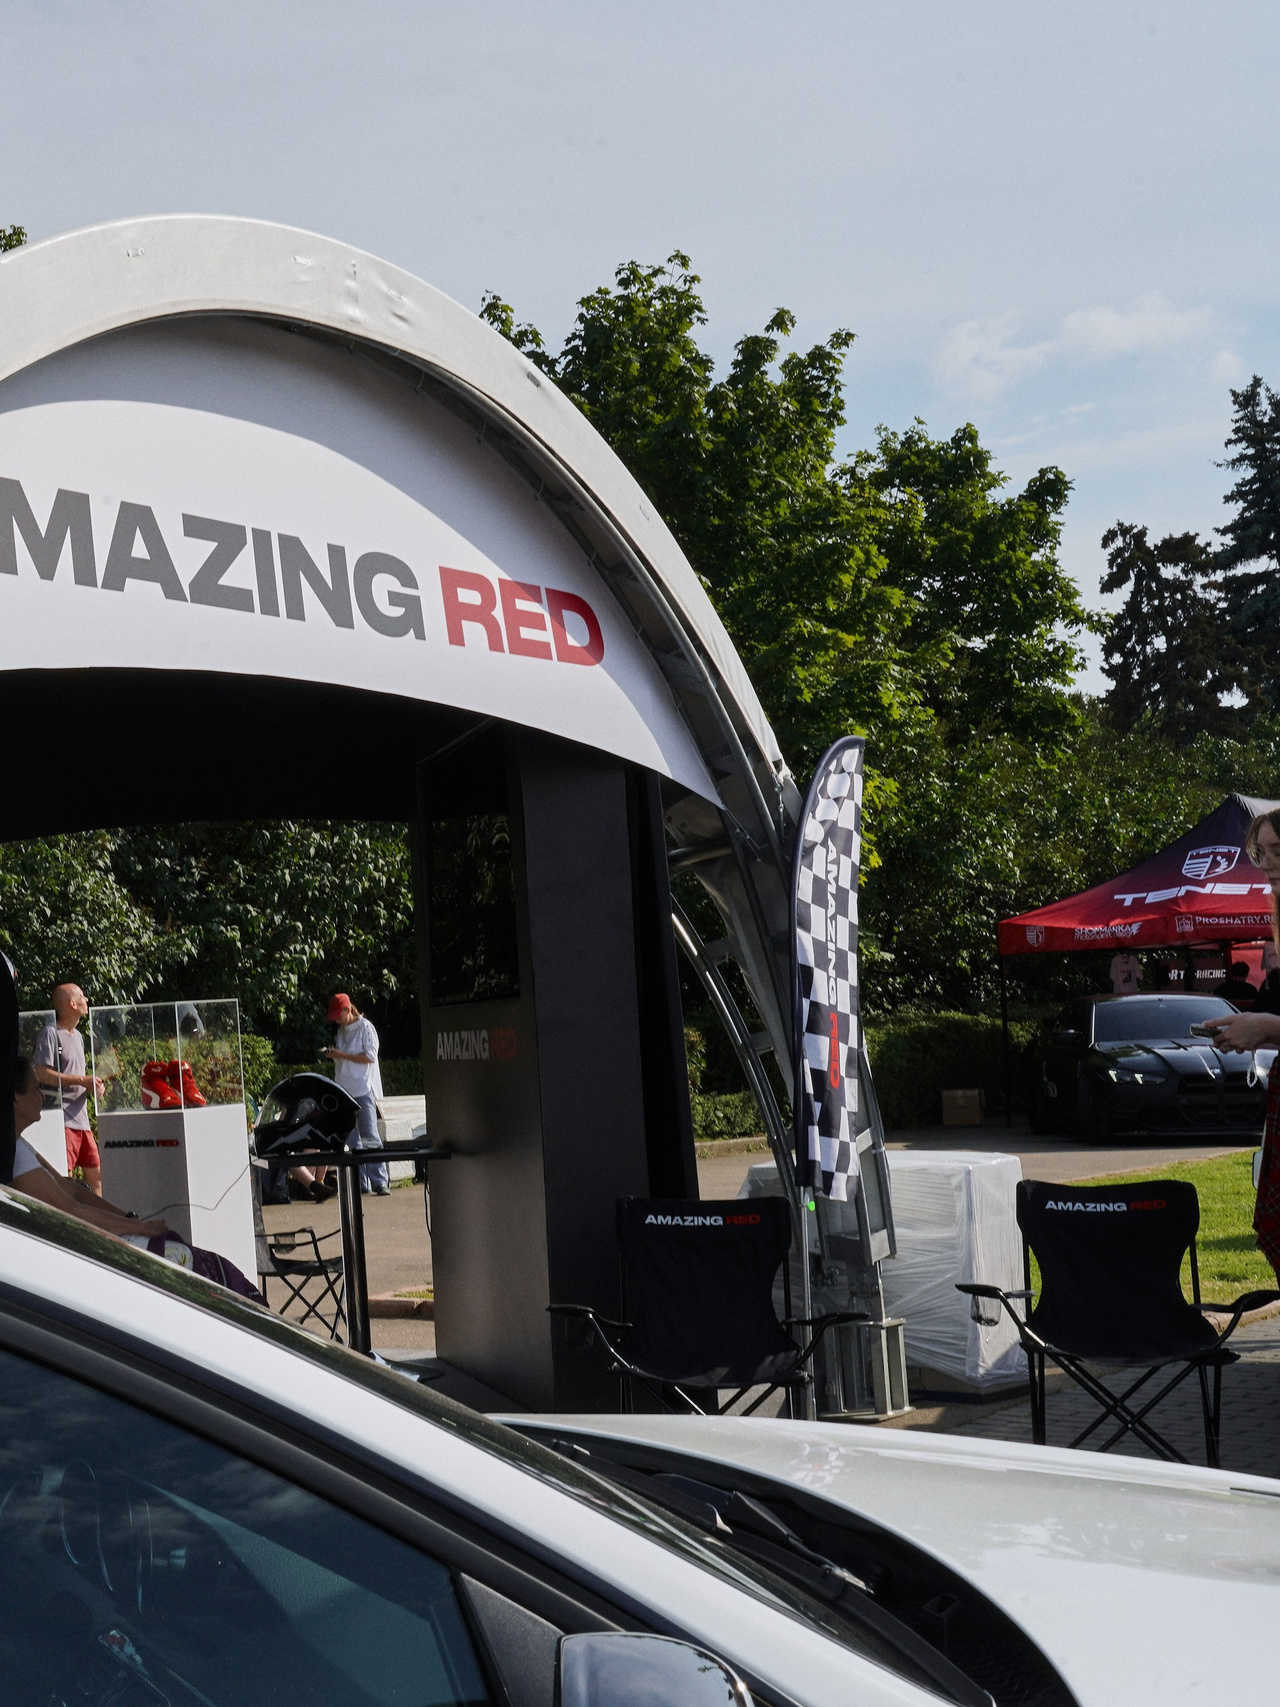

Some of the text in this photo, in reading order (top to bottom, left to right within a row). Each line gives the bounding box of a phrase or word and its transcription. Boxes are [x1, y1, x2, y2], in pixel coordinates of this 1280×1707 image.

[438, 565, 604, 667] RED
[1113, 883, 1272, 906] TENET
[827, 837, 841, 1089] AMAZING RED
[436, 1029, 490, 1061] AMAZING
[104, 1140, 155, 1149] AMAZING
[1045, 1199, 1167, 1212] AMAZING RED
[644, 1214, 761, 1226] AMAZING RED
